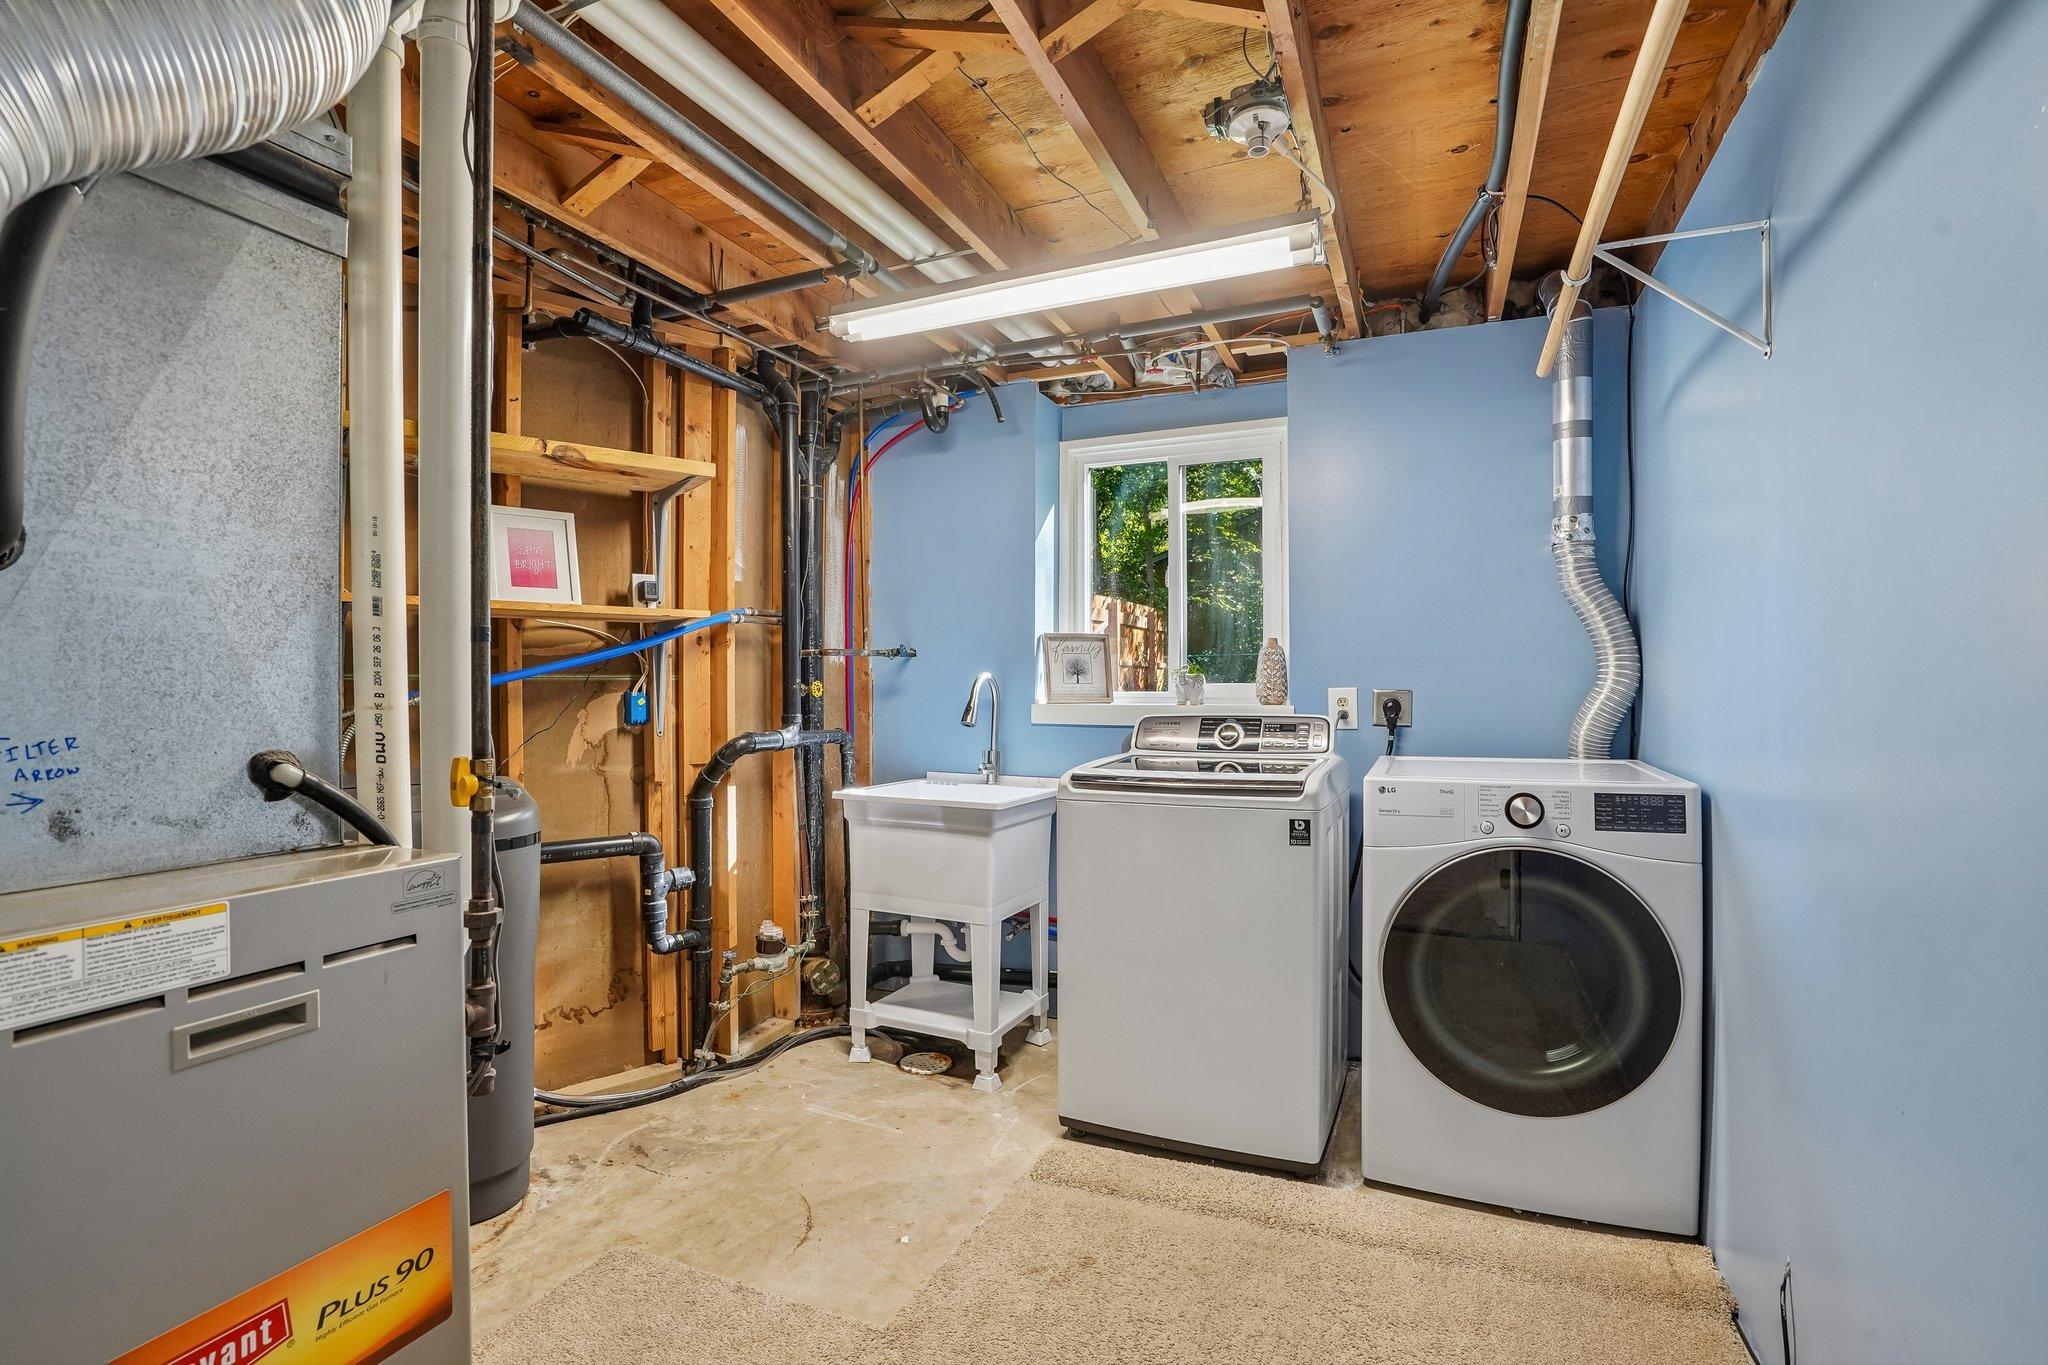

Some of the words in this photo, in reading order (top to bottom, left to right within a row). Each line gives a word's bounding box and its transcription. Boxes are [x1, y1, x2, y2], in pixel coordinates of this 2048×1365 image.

[1050, 638, 1102, 663] family
[373, 656, 382, 668] SEP
[374, 671, 382, 686] 2004
[14, 766, 80, 782] ARROW
[142, 909, 202, 925] AVERTISSEMENT
[16, 936, 60, 949] WARNING
[317, 1275, 390, 1331] PLUS
[396, 1247, 434, 1286] 90
[315, 1326, 337, 1342] Highly
[339, 1310, 364, 1329] Efficient
[366, 1302, 379, 1312] Gas
